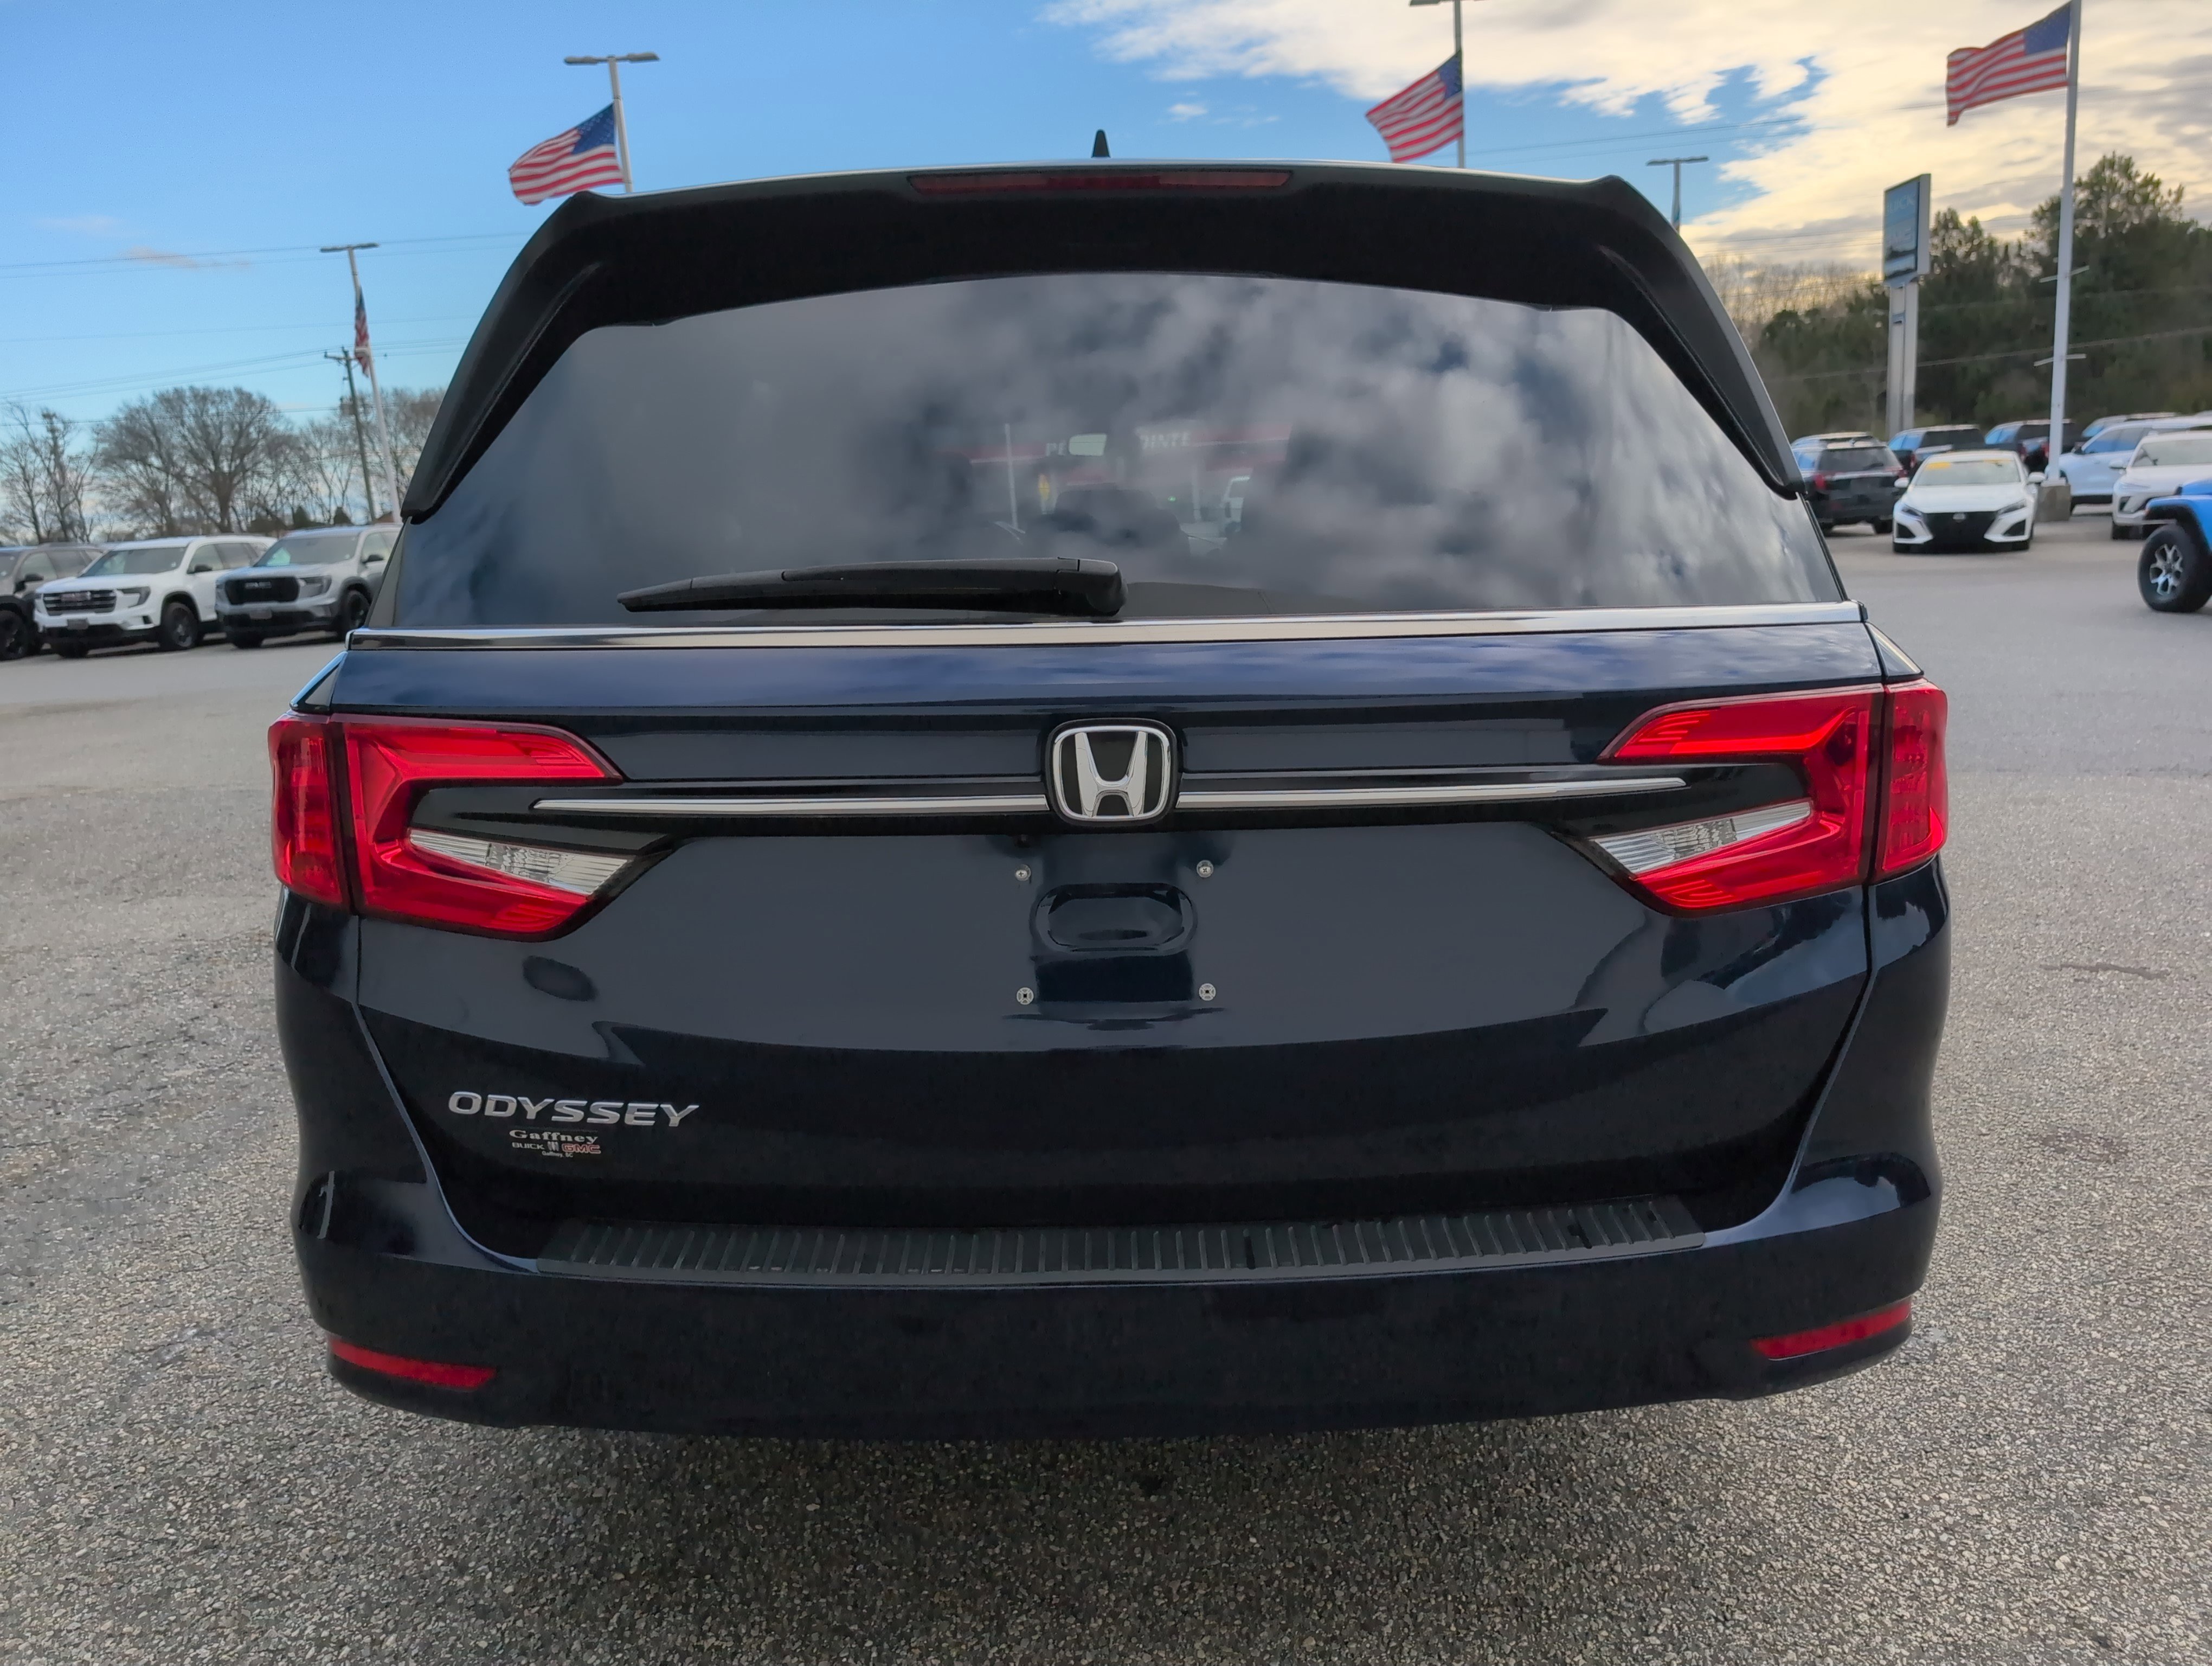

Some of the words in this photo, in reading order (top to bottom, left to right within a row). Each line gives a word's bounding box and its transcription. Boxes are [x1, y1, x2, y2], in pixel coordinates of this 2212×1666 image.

[448, 1091, 699, 1127] ODYSSEY
[509, 1130, 598, 1144] Gaffney
[562, 1143, 601, 1154] GMC
